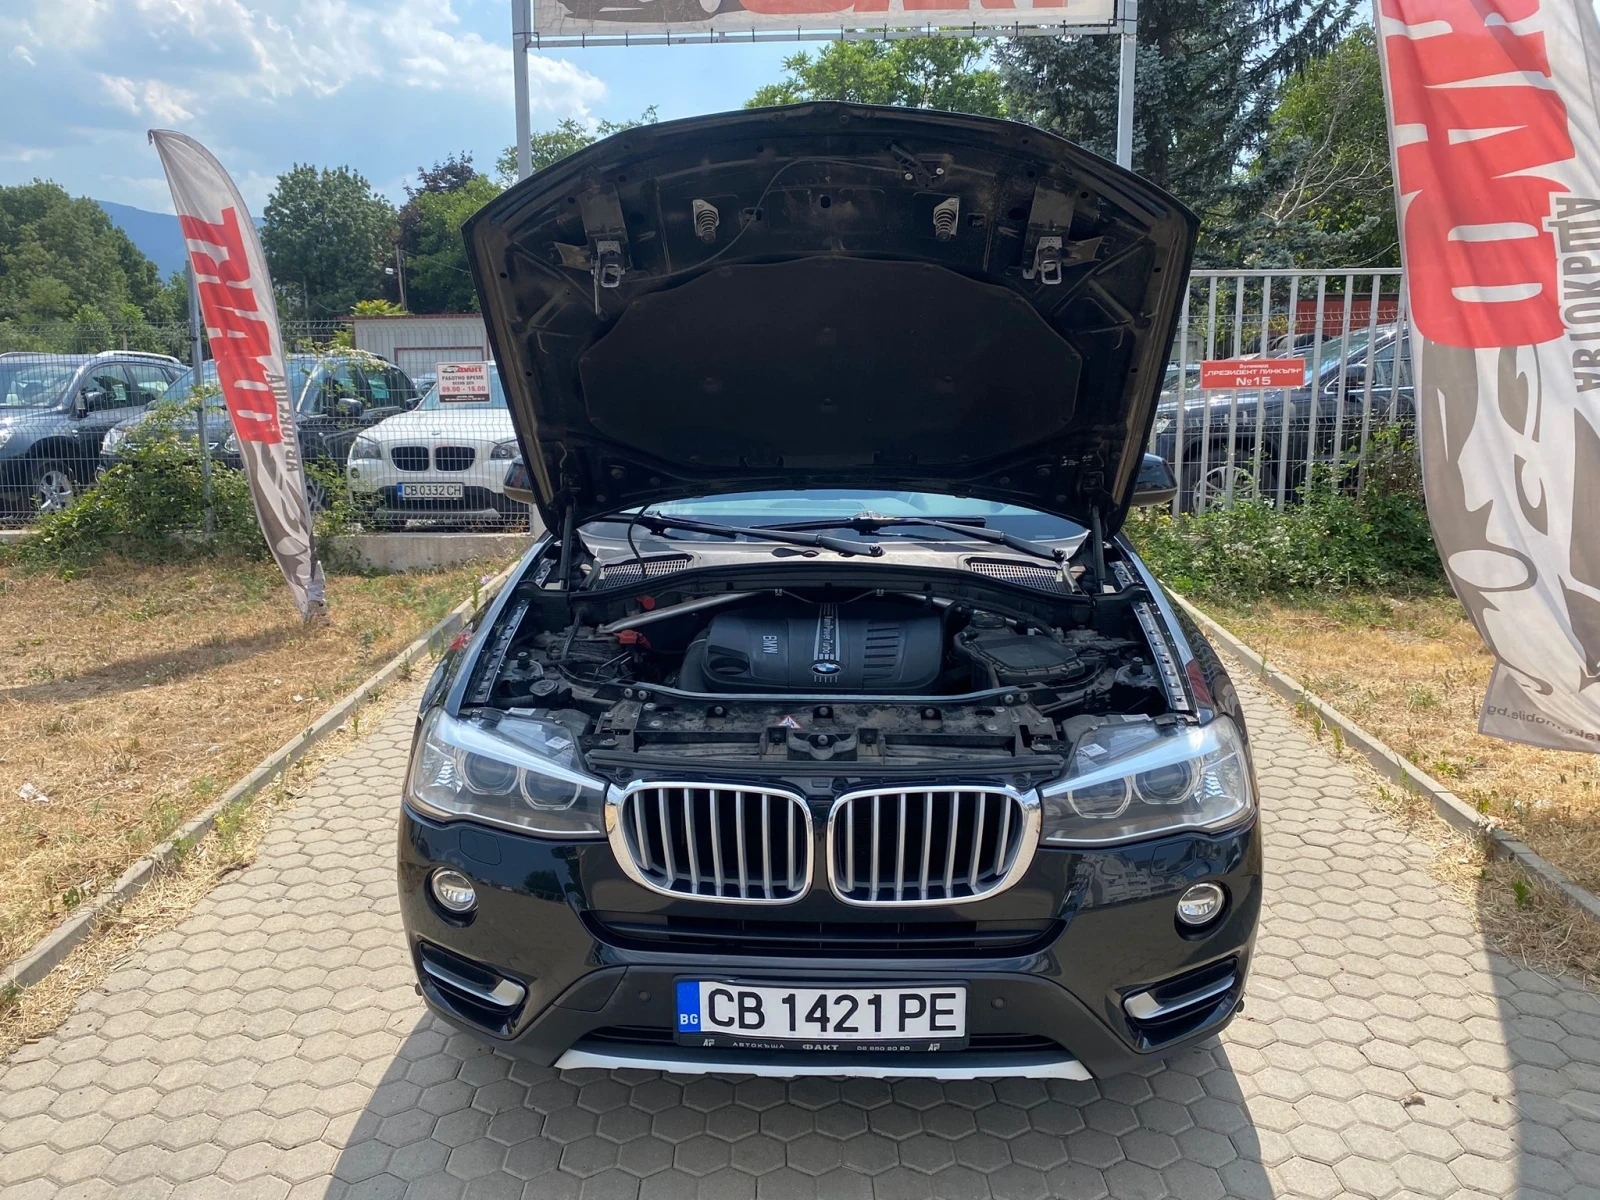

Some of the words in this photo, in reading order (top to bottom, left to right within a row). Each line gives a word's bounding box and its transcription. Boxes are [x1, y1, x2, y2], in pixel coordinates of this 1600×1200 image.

[419, 485, 445, 496] 0332
[763, 635, 778, 653] BMW
[708, 988, 765, 1030] CB
[781, 993, 882, 1032] 1421
[898, 993, 957, 1032] PE
[680, 1013, 698, 1025] BG
